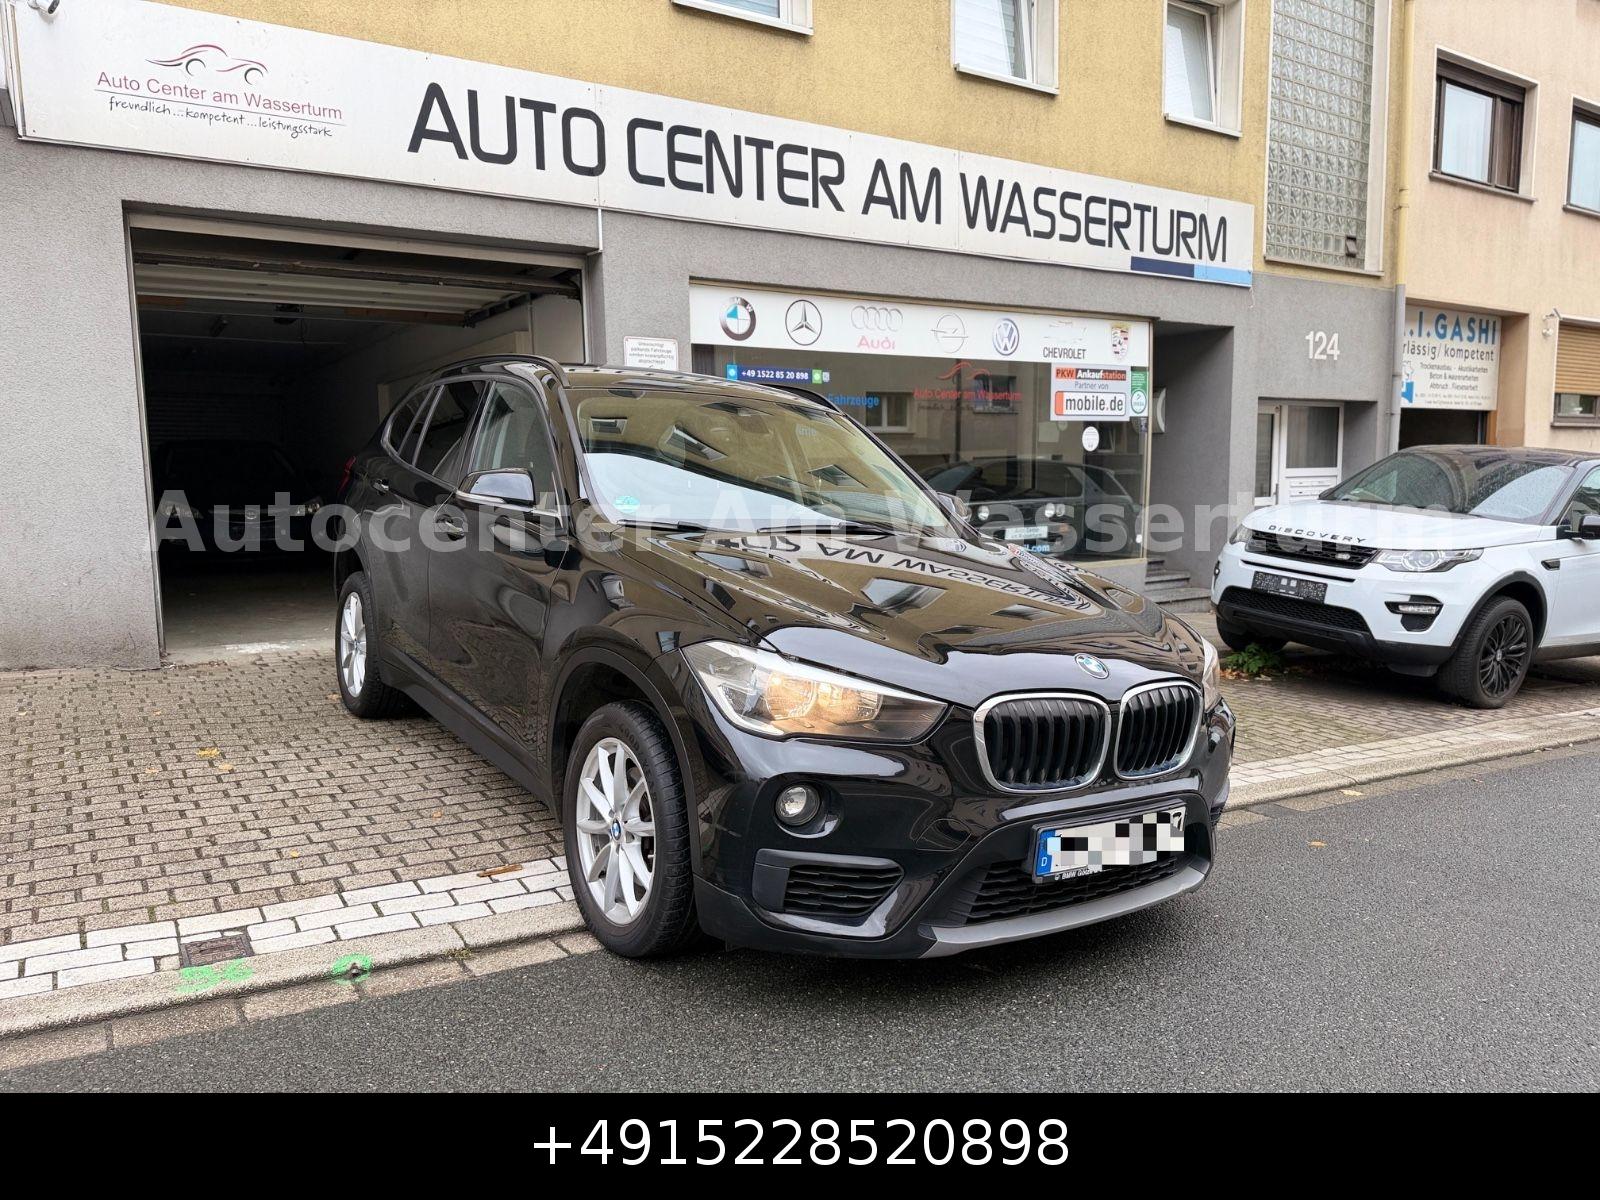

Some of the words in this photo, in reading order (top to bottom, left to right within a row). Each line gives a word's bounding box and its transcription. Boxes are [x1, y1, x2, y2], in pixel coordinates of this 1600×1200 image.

[97, 71, 140, 91] Auto
[147, 78, 207, 100] Center
[212, 91, 239, 105] am
[243, 92, 343, 119] Wasserturm
[407, 82, 607, 177] AUTO
[626, 117, 846, 212] CENTER
[861, 158, 942, 225] AM
[959, 172, 1228, 263] WASSERTURM
[857, 335, 896, 350] Audi
[1304, 330, 1341, 361] 124
[1042, 346, 1087, 360] CHEVROLET
[1443, 343, 1495, 362] kompetent
[741, 369, 756, 378] +49
[757, 370, 775, 379] 1522
[785, 371, 795, 380] 20
[1056, 368, 1075, 379] PKW
[1076, 369, 1126, 380] Ankaufstation
[1074, 381, 1096, 390] Partner
[1097, 382, 1109, 390] von
[1065, 395, 1124, 412] mobile.de
[1268, 524, 1367, 544] DISCOVERY
[1041, 856, 1048, 867] D
